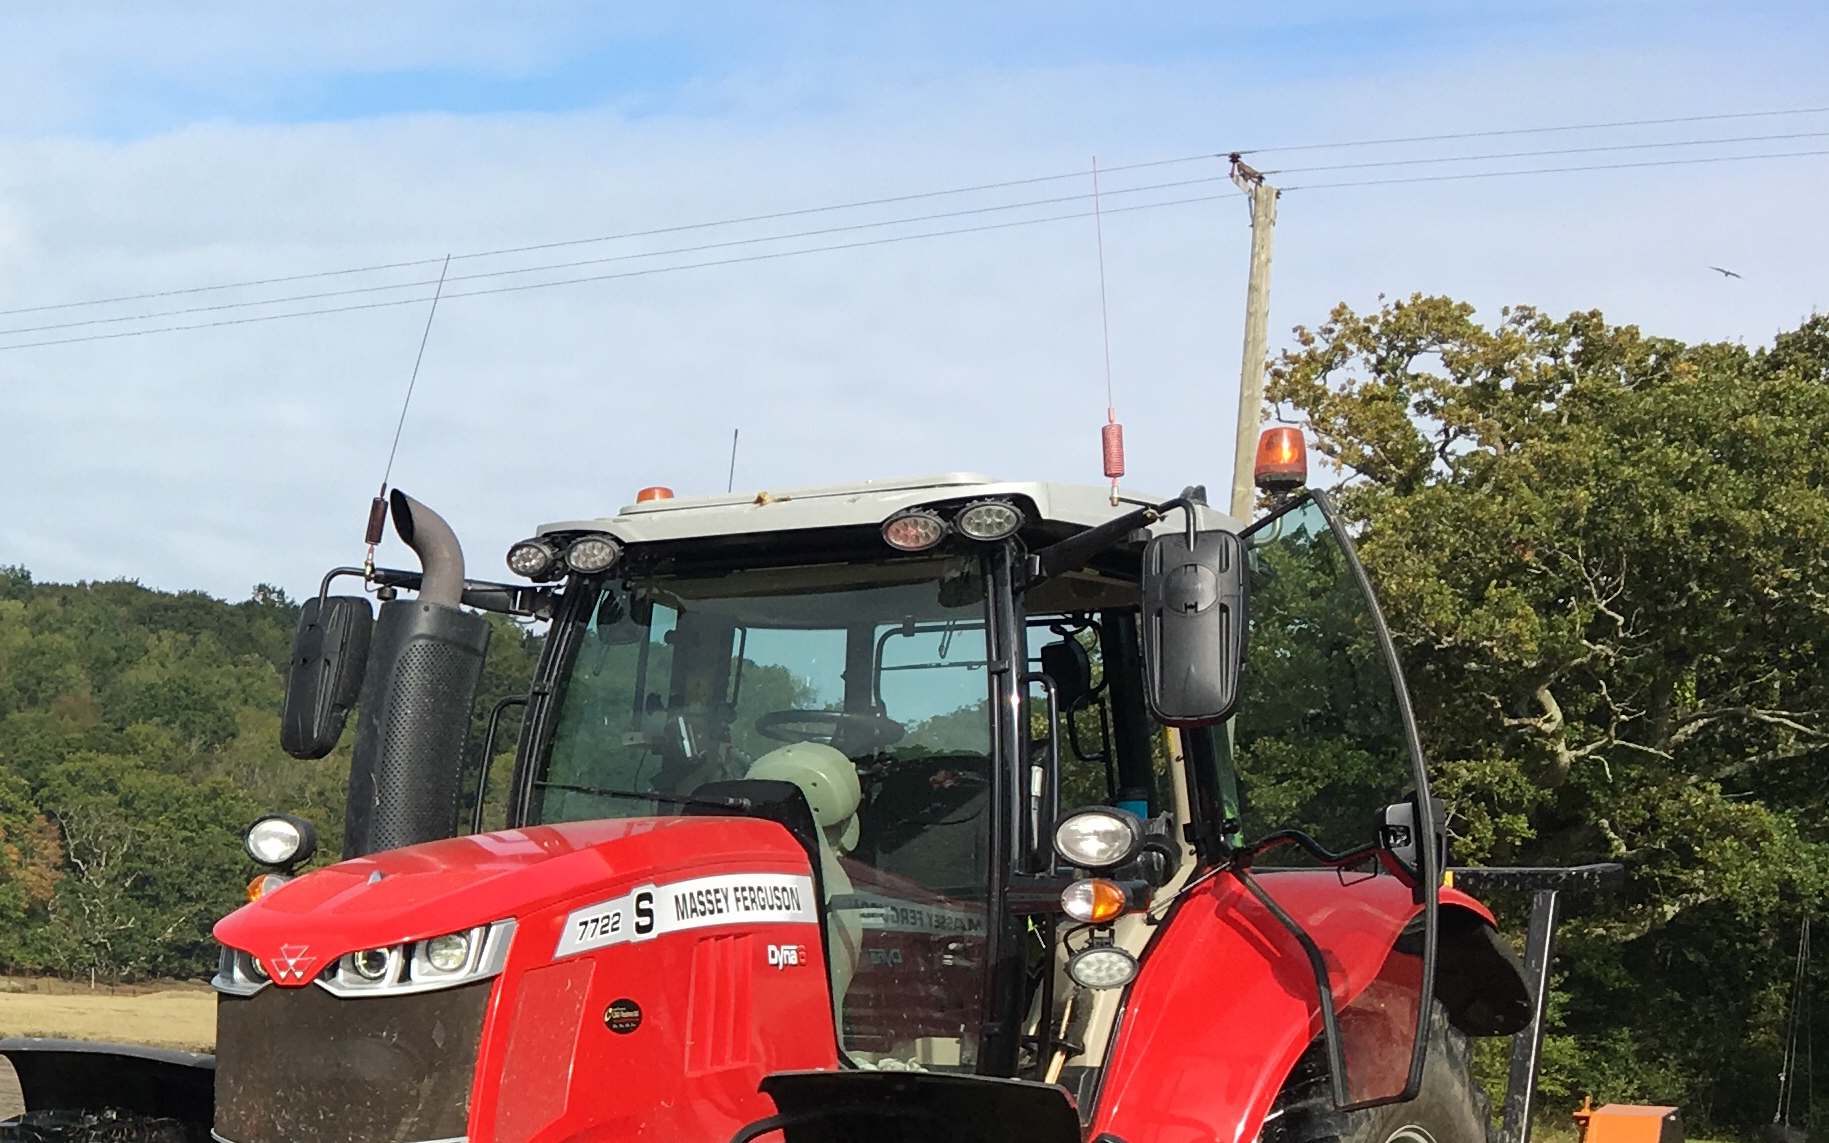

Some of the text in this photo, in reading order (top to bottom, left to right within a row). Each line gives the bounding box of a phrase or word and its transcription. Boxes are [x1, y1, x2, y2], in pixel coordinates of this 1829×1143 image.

[578, 885, 801, 941] 7722 S MASSEY FERGUSON
